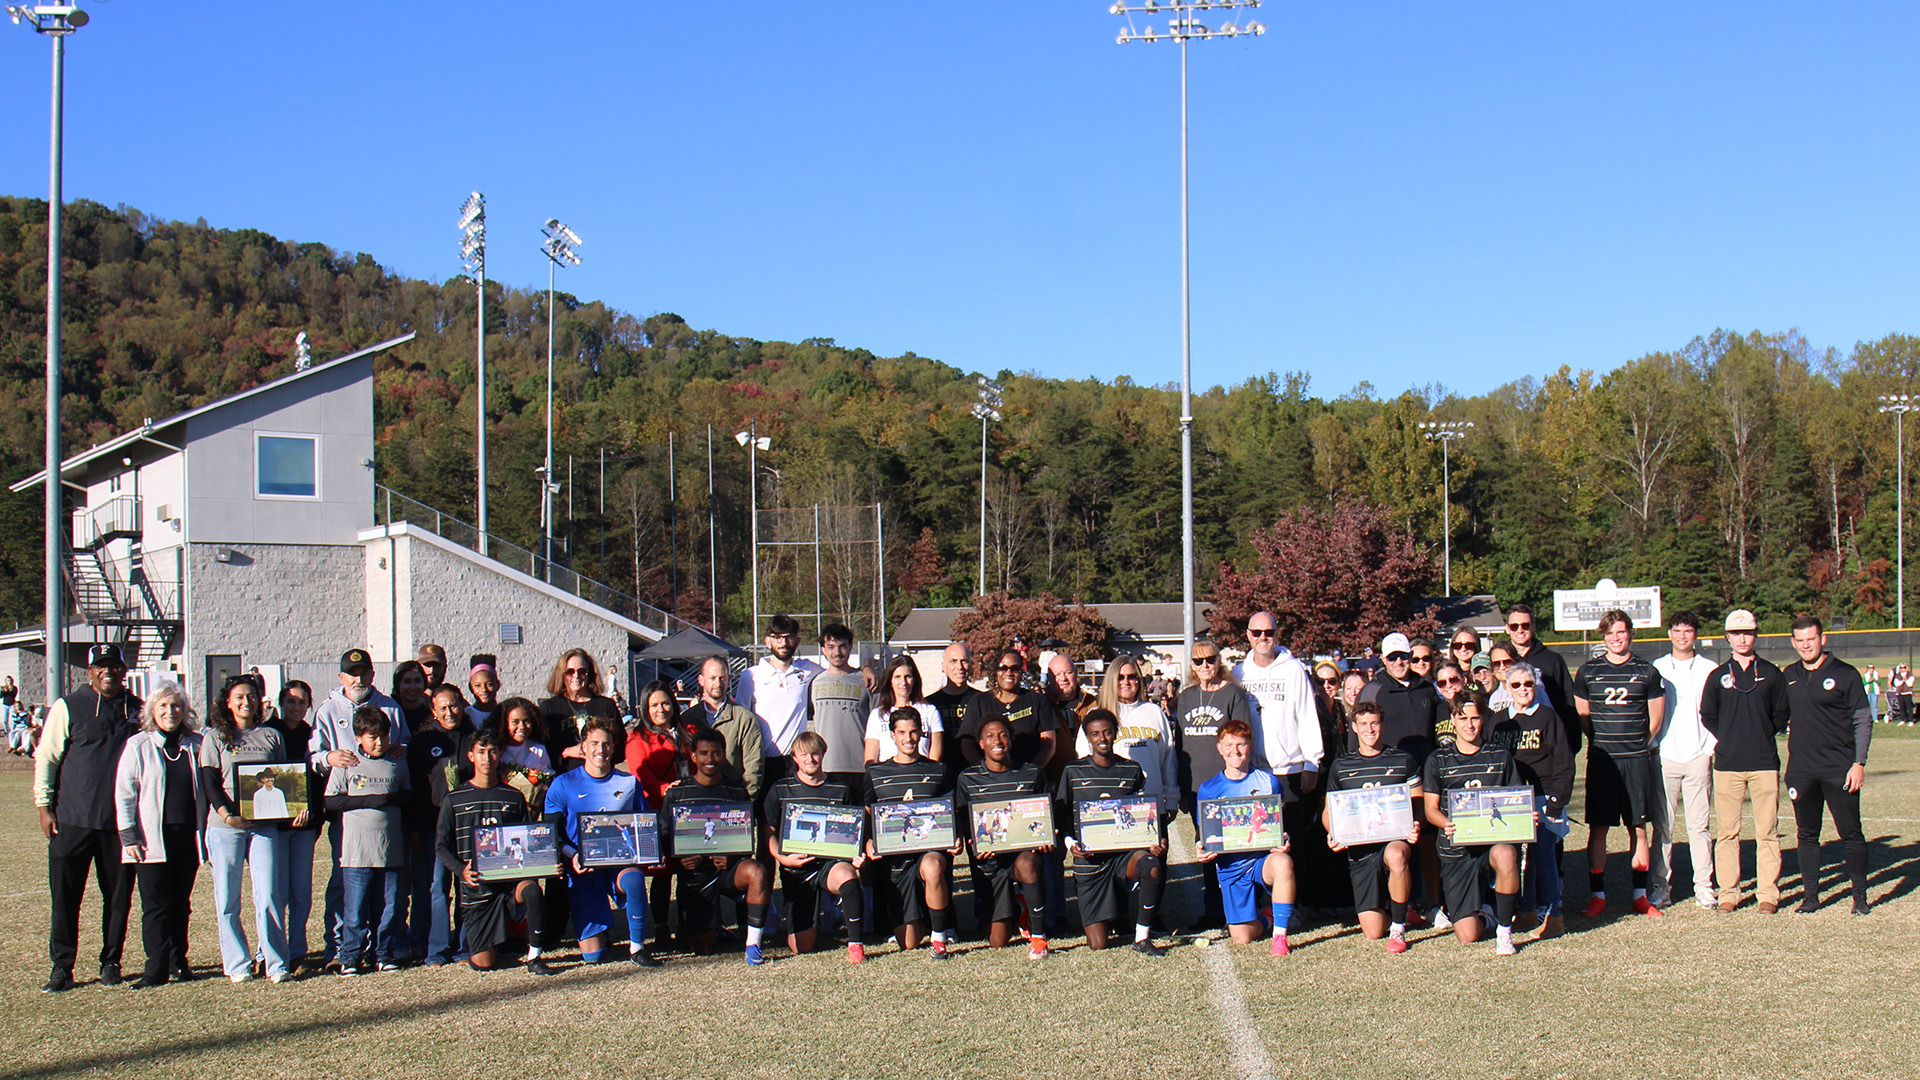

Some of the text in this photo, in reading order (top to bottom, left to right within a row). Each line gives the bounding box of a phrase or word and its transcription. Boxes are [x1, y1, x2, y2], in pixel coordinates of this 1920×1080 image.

[1615, 590, 1651, 598] PANTHERS
[101, 644, 111, 655] F
[814, 683, 862, 698] FERRUM
[1603, 687, 1628, 705] 22
[1184, 706, 1224, 721] FERRUM
[1192, 717, 1212, 725] 1913
[1113, 726, 1161, 742] ERRUM
[1184, 726, 1219, 736] COLLEGE
[903, 788, 914, 800] 4
